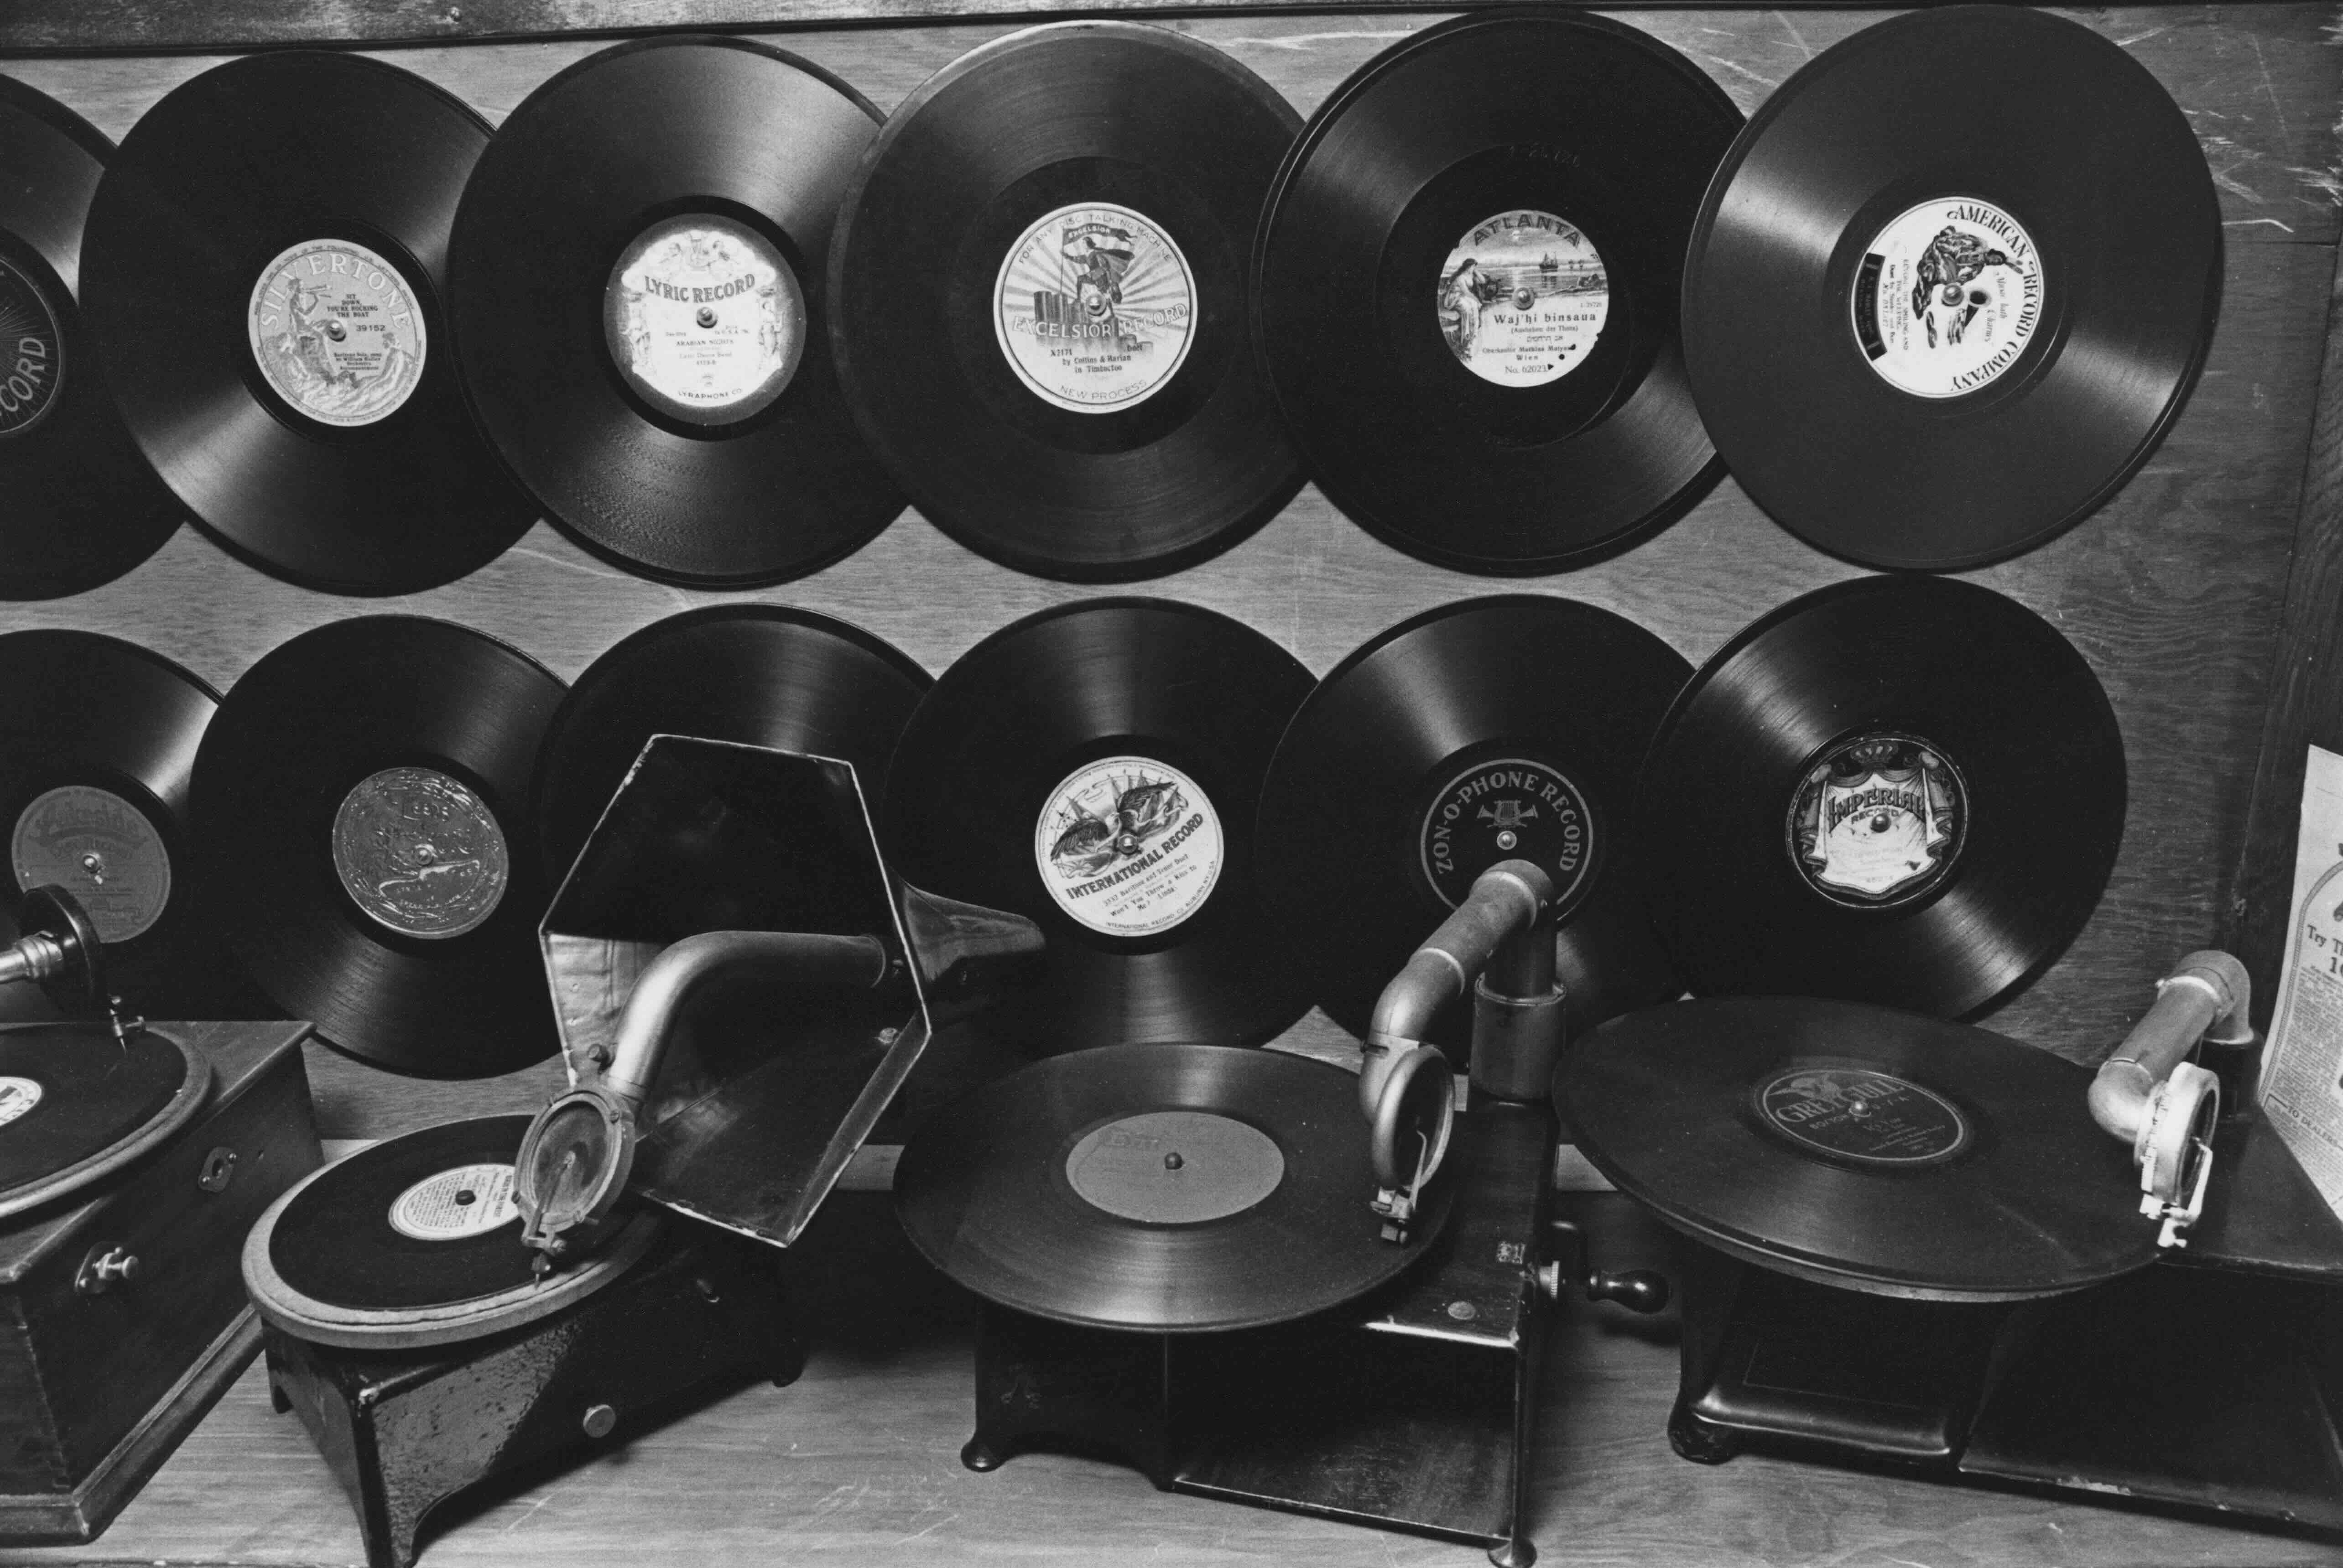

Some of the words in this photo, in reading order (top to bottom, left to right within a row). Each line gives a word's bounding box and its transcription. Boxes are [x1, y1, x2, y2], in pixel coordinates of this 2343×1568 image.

[1018, 244, 1034, 264] FOR
[1036, 229, 1053, 244] ANY
[1058, 215, 1081, 227] DISC
[1089, 214, 1134, 230] TALKING
[1137, 228, 1172, 261] MACHINE
[1068, 225, 1111, 239] EXCELSIOR
[1474, 214, 1581, 248] ATLANTA
[1947, 205, 2030, 258] AMERICAN
[261, 253, 410, 330] SILVERTONE
[645, 275, 689, 303] LYRIC
[692, 273, 755, 303] RECORD
[2015, 261, 2039, 338] RECORD
[1012, 315, 1112, 339] EXCELSIOR
[1122, 302, 1187, 335] RECORD
[1505, 365, 1518, 374] No.
[1950, 341, 2018, 391] COMPANY
[677, 390, 729, 399] LYRAPHONE
[1059, 385, 1088, 399] NEW
[1091, 379, 1147, 400] PROCESS
[1433, 771, 1539, 874] ZON-O-PHONE
[1540, 781, 1581, 871] RECORD
[1828, 787, 1926, 833] IMPERIAL
[1066, 849, 1163, 899] INTERNATIONAL
[1161, 813, 1203, 854] RECORD
[2307, 923, 2327, 948] Try
